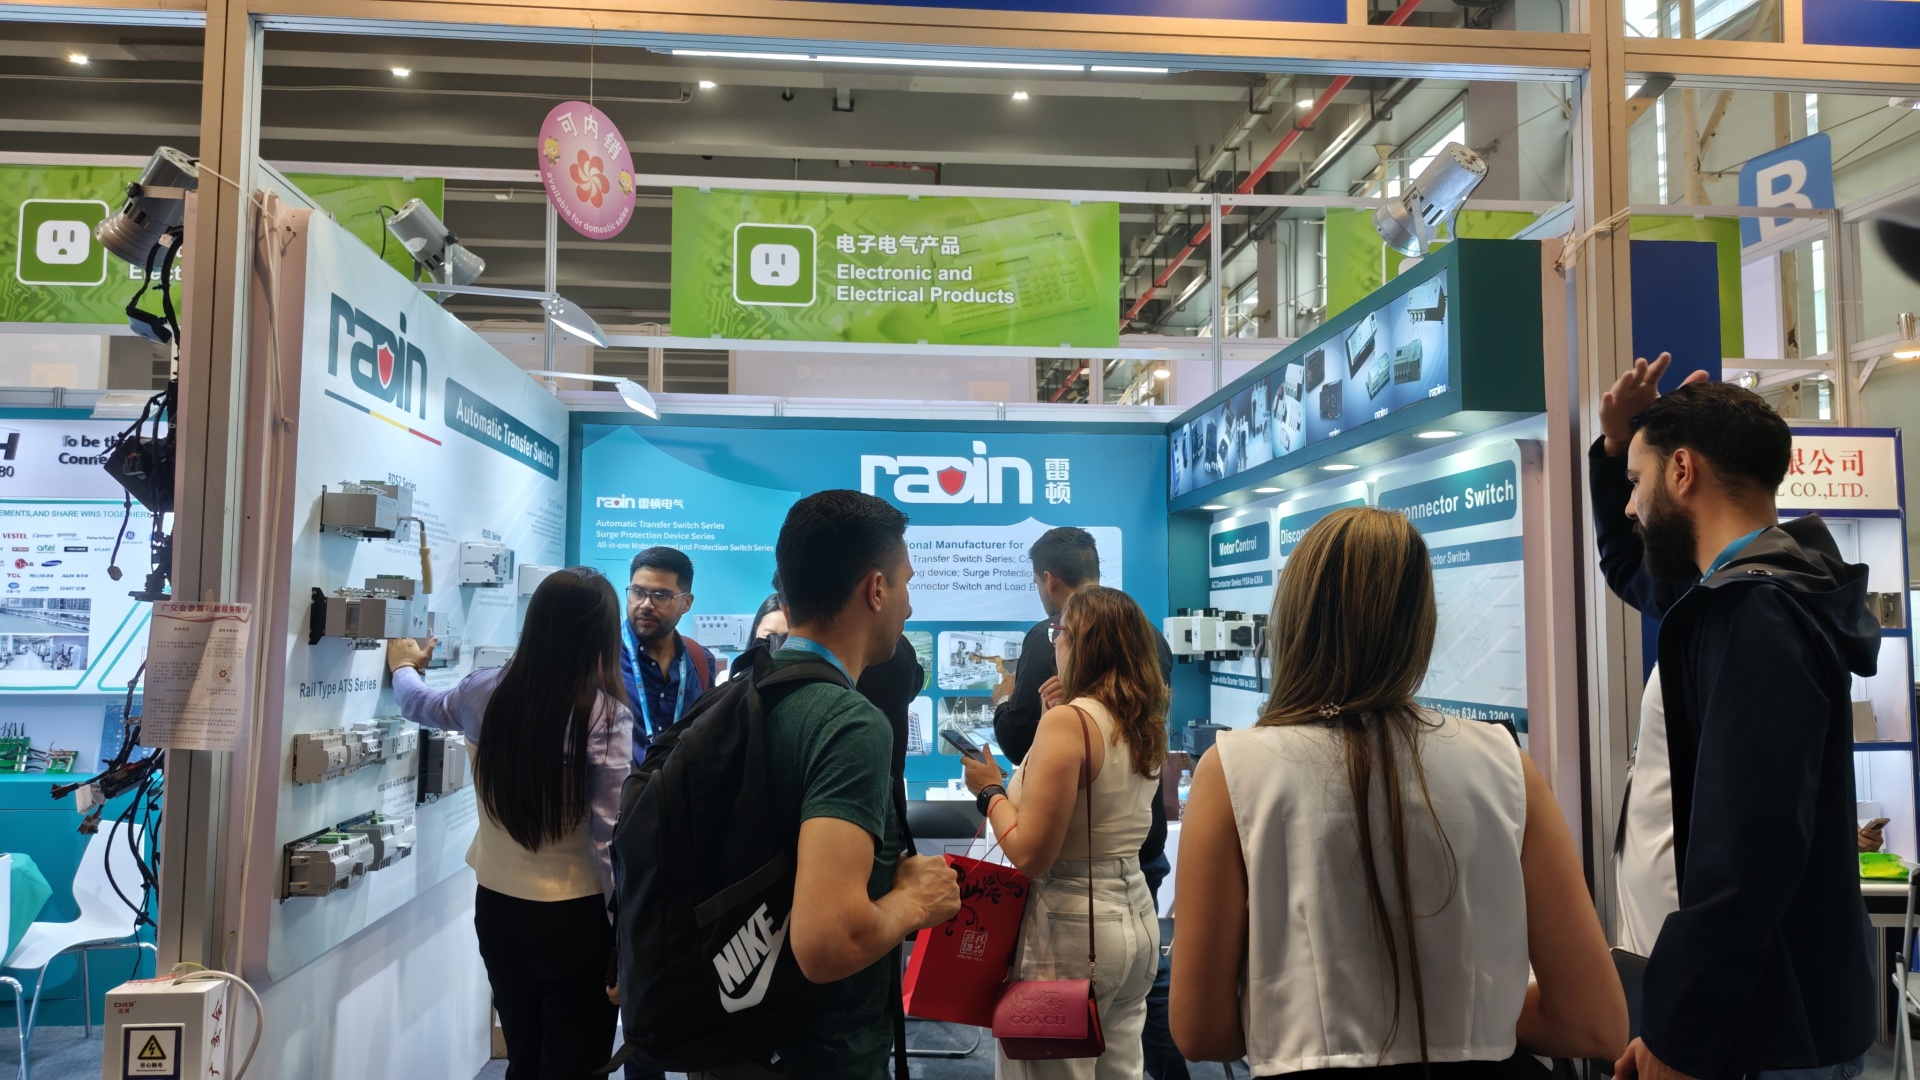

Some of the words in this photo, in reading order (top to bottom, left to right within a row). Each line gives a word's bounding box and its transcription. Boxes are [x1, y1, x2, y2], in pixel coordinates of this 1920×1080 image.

[547, 171, 571, 217] available
[572, 212, 583, 226] for
[584, 221, 616, 233] domestic
[615, 206, 629, 226] sales
[1756, 160, 1814, 241] B
[836, 234, 960, 256] 电子电气产品
[836, 264, 932, 281] Electronic
[937, 266, 972, 281] and
[836, 286, 924, 303] Electrical
[930, 287, 1015, 305] Products
[456, 397, 502, 441] Automatic
[504, 423, 534, 458] Transfer
[533, 441, 554, 469] Switch
[61, 435, 78, 448] To
[81, 435, 100, 448] be
[1045, 458, 1071, 504] 雷顿
[1464, 479, 1514, 509] Switch
[1790, 482, 1868, 499] CO.,LTD.
[638, 498, 684, 510] 雷顿电气
[596, 520, 638, 528] Automatic
[639, 520, 672, 528] Transfer
[672, 521, 700, 529] Switch
[701, 522, 725, 530] Series
[596, 530, 619, 540] Surge
[620, 530, 662, 539] Protection
[664, 532, 690, 540] Device
[691, 532, 715, 540] Series
[597, 541, 630, 549] All-in-one
[680, 543, 692, 551] and
[936, 540, 1006, 550] Manufacturer
[1010, 540, 1024, 550] for
[1220, 543, 1235, 556] Motor
[1236, 536, 1257, 554] Control
[912, 554, 950, 563] Transfer
[952, 554, 983, 563] Switch
[986, 555, 1016, 564] Series;
[1448, 549, 1470, 564] Switch
[928, 568, 960, 578] device;
[963, 568, 990, 578] Surge
[952, 582, 982, 590] Switch
[985, 582, 1002, 590] and
[1004, 582, 1026, 590] Load
[300, 682, 316, 698] Rail
[318, 681, 337, 700] Type
[338, 678, 353, 694] ATS
[354, 676, 377, 692] Series
[1462, 706, 1477, 720] 63A
[1478, 710, 1486, 720] to
[712, 902, 780, 994] NIKE
[1010, 1016, 1066, 1025] COACH
